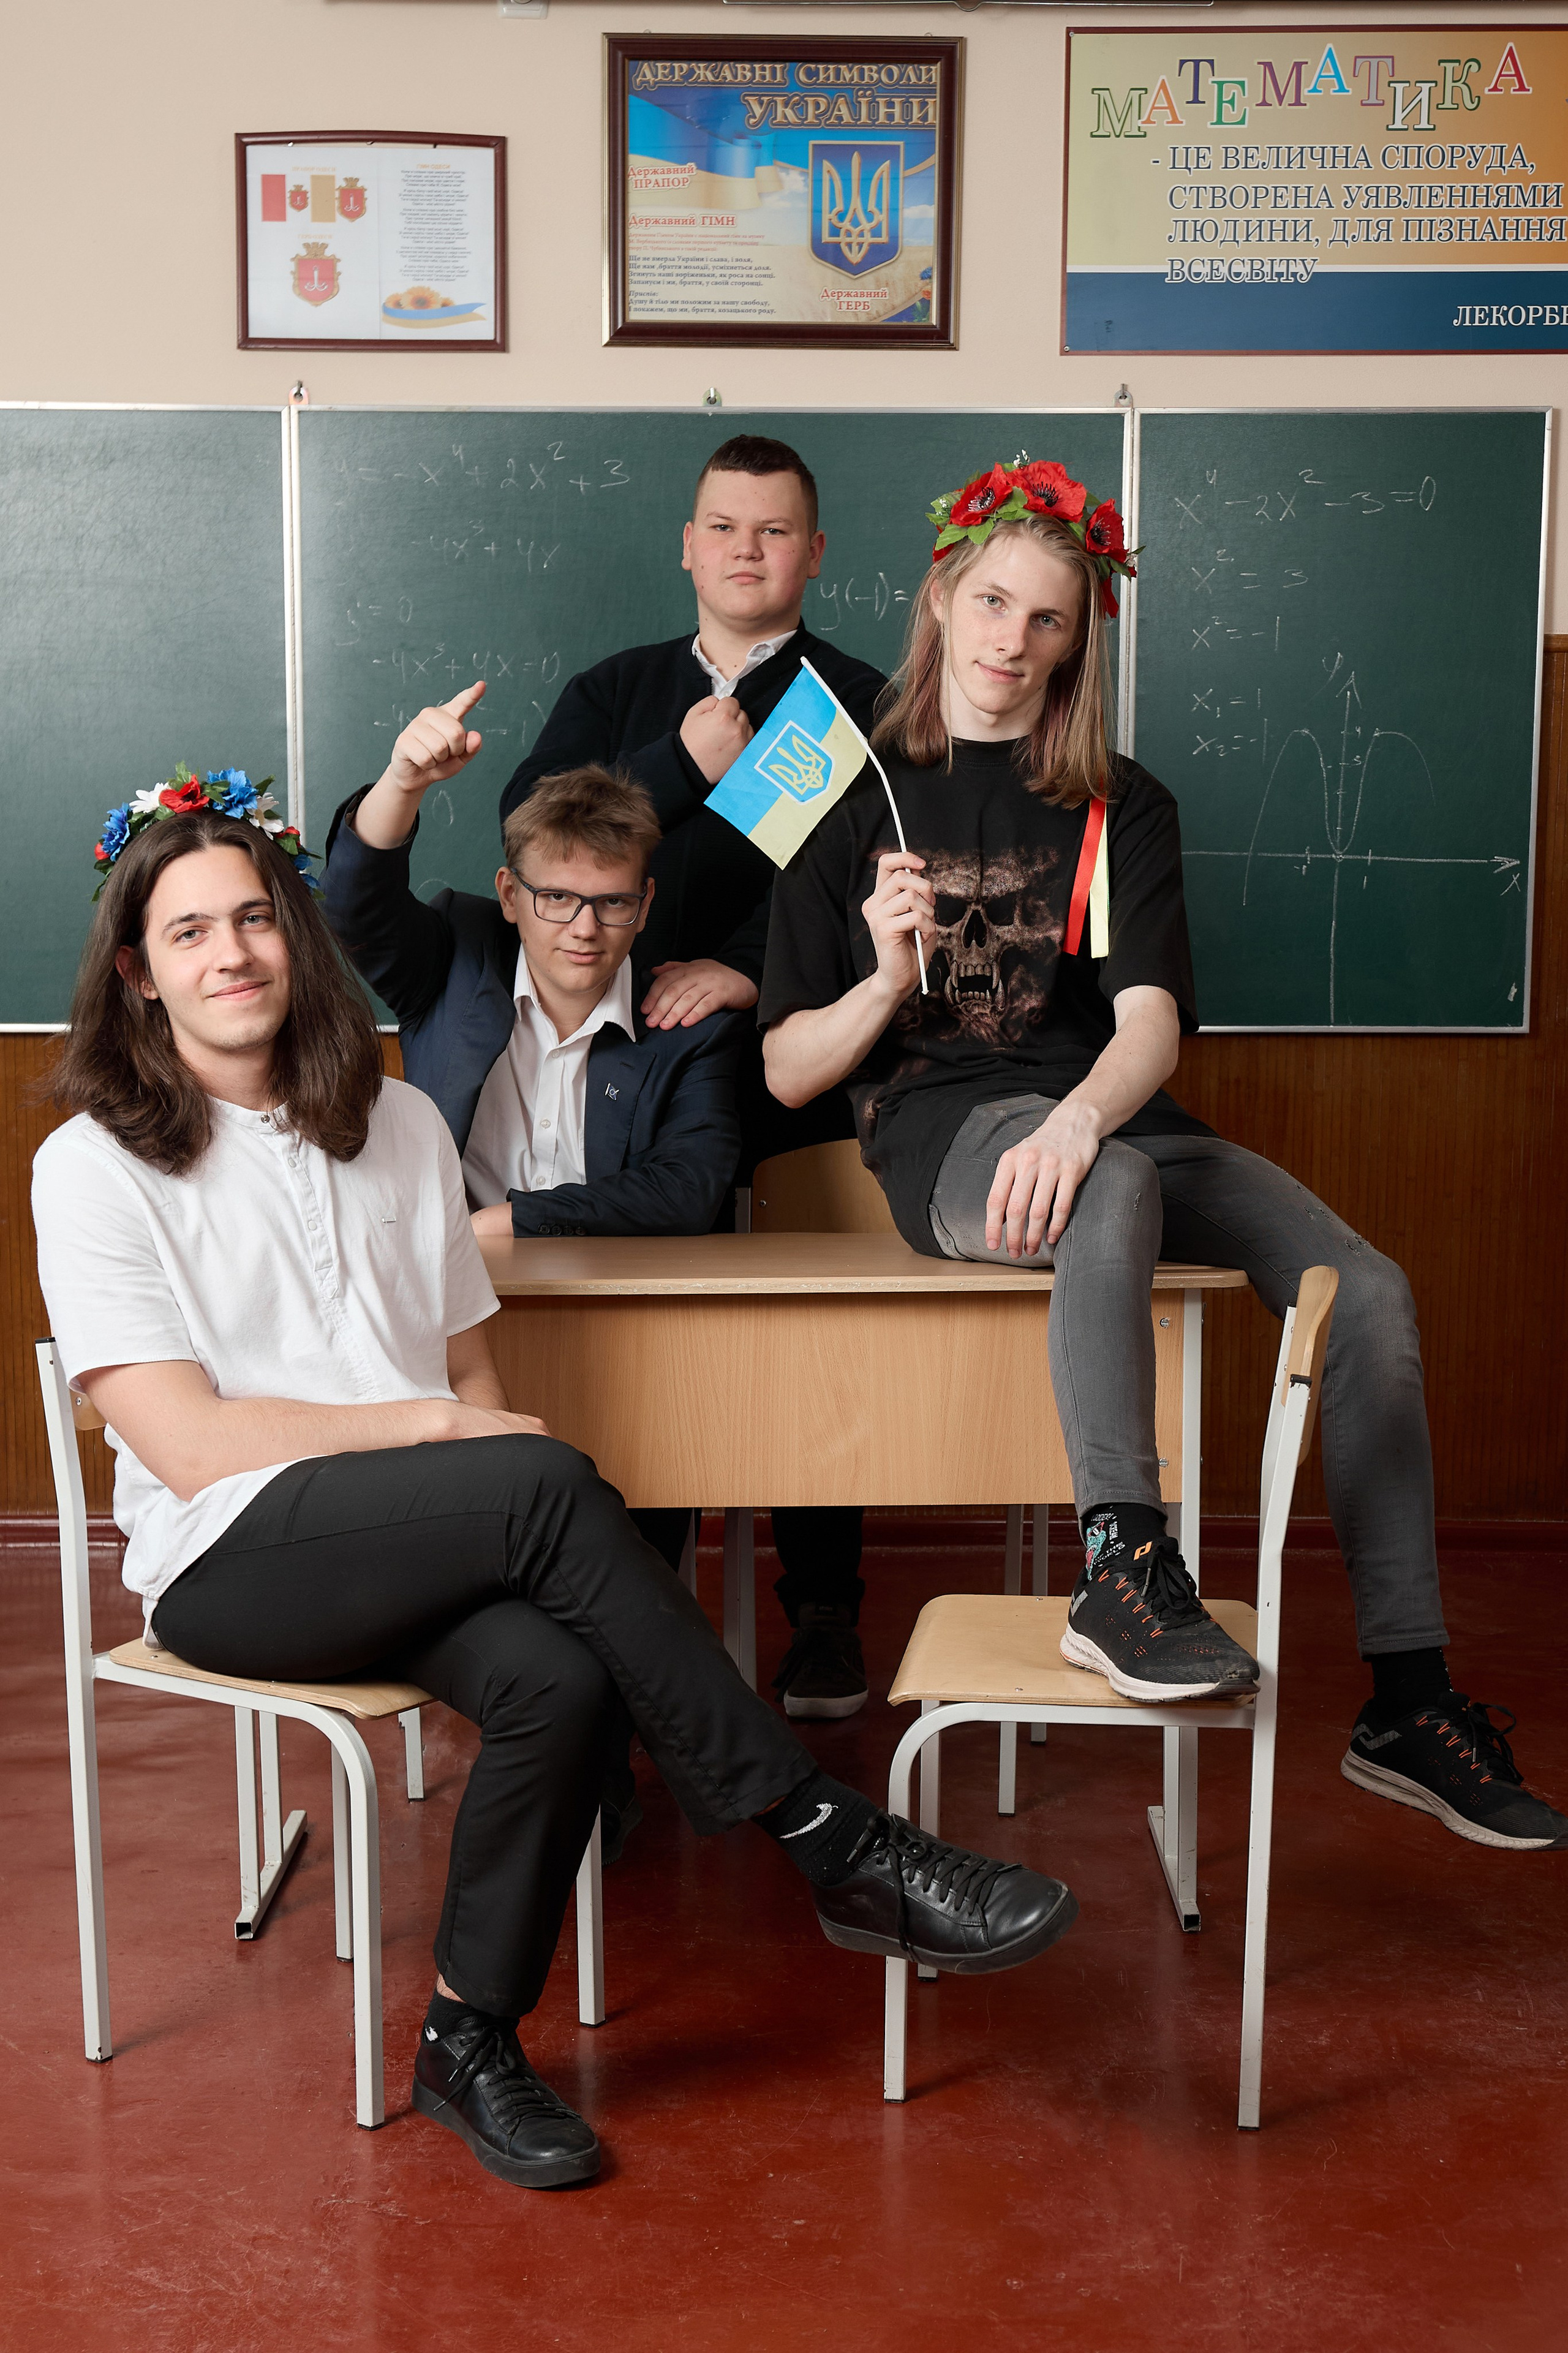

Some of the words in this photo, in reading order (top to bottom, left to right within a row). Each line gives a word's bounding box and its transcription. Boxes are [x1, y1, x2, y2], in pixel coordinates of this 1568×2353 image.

[635, 62, 785, 86] ДЕРЖАВНІ
[798, 64, 937, 85] СИМВОЛИ
[1090, 44, 1532, 138] МАТЕМАТИКА
[744, 91, 937, 125] УКРАЇНИ
[628, 164, 695, 177] Державний
[1169, 146, 1212, 175] ЦЕ
[1221, 145, 1373, 170] ВЕЛИЧНА
[1381, 144, 1535, 175] СПОРУДА,
[633, 177, 690, 189] ПРАПОР
[1169, 185, 1335, 210] СТВОРЕНА
[1343, 184, 1563, 209] УЯВЛЕННЯМИ
[628, 215, 695, 229] Державний
[701, 216, 736, 226] ГІМН
[1167, 219, 1320, 248] ЛЮДИНИ,
[1329, 218, 1393, 248] ДЛЯ
[1402, 217, 1567, 242] ПІЗНАННЯ
[1166, 258, 1319, 283] ВСЕСВІТУ
[821, 288, 888, 301] Державний
[837, 301, 870, 311] ГЕРБ
